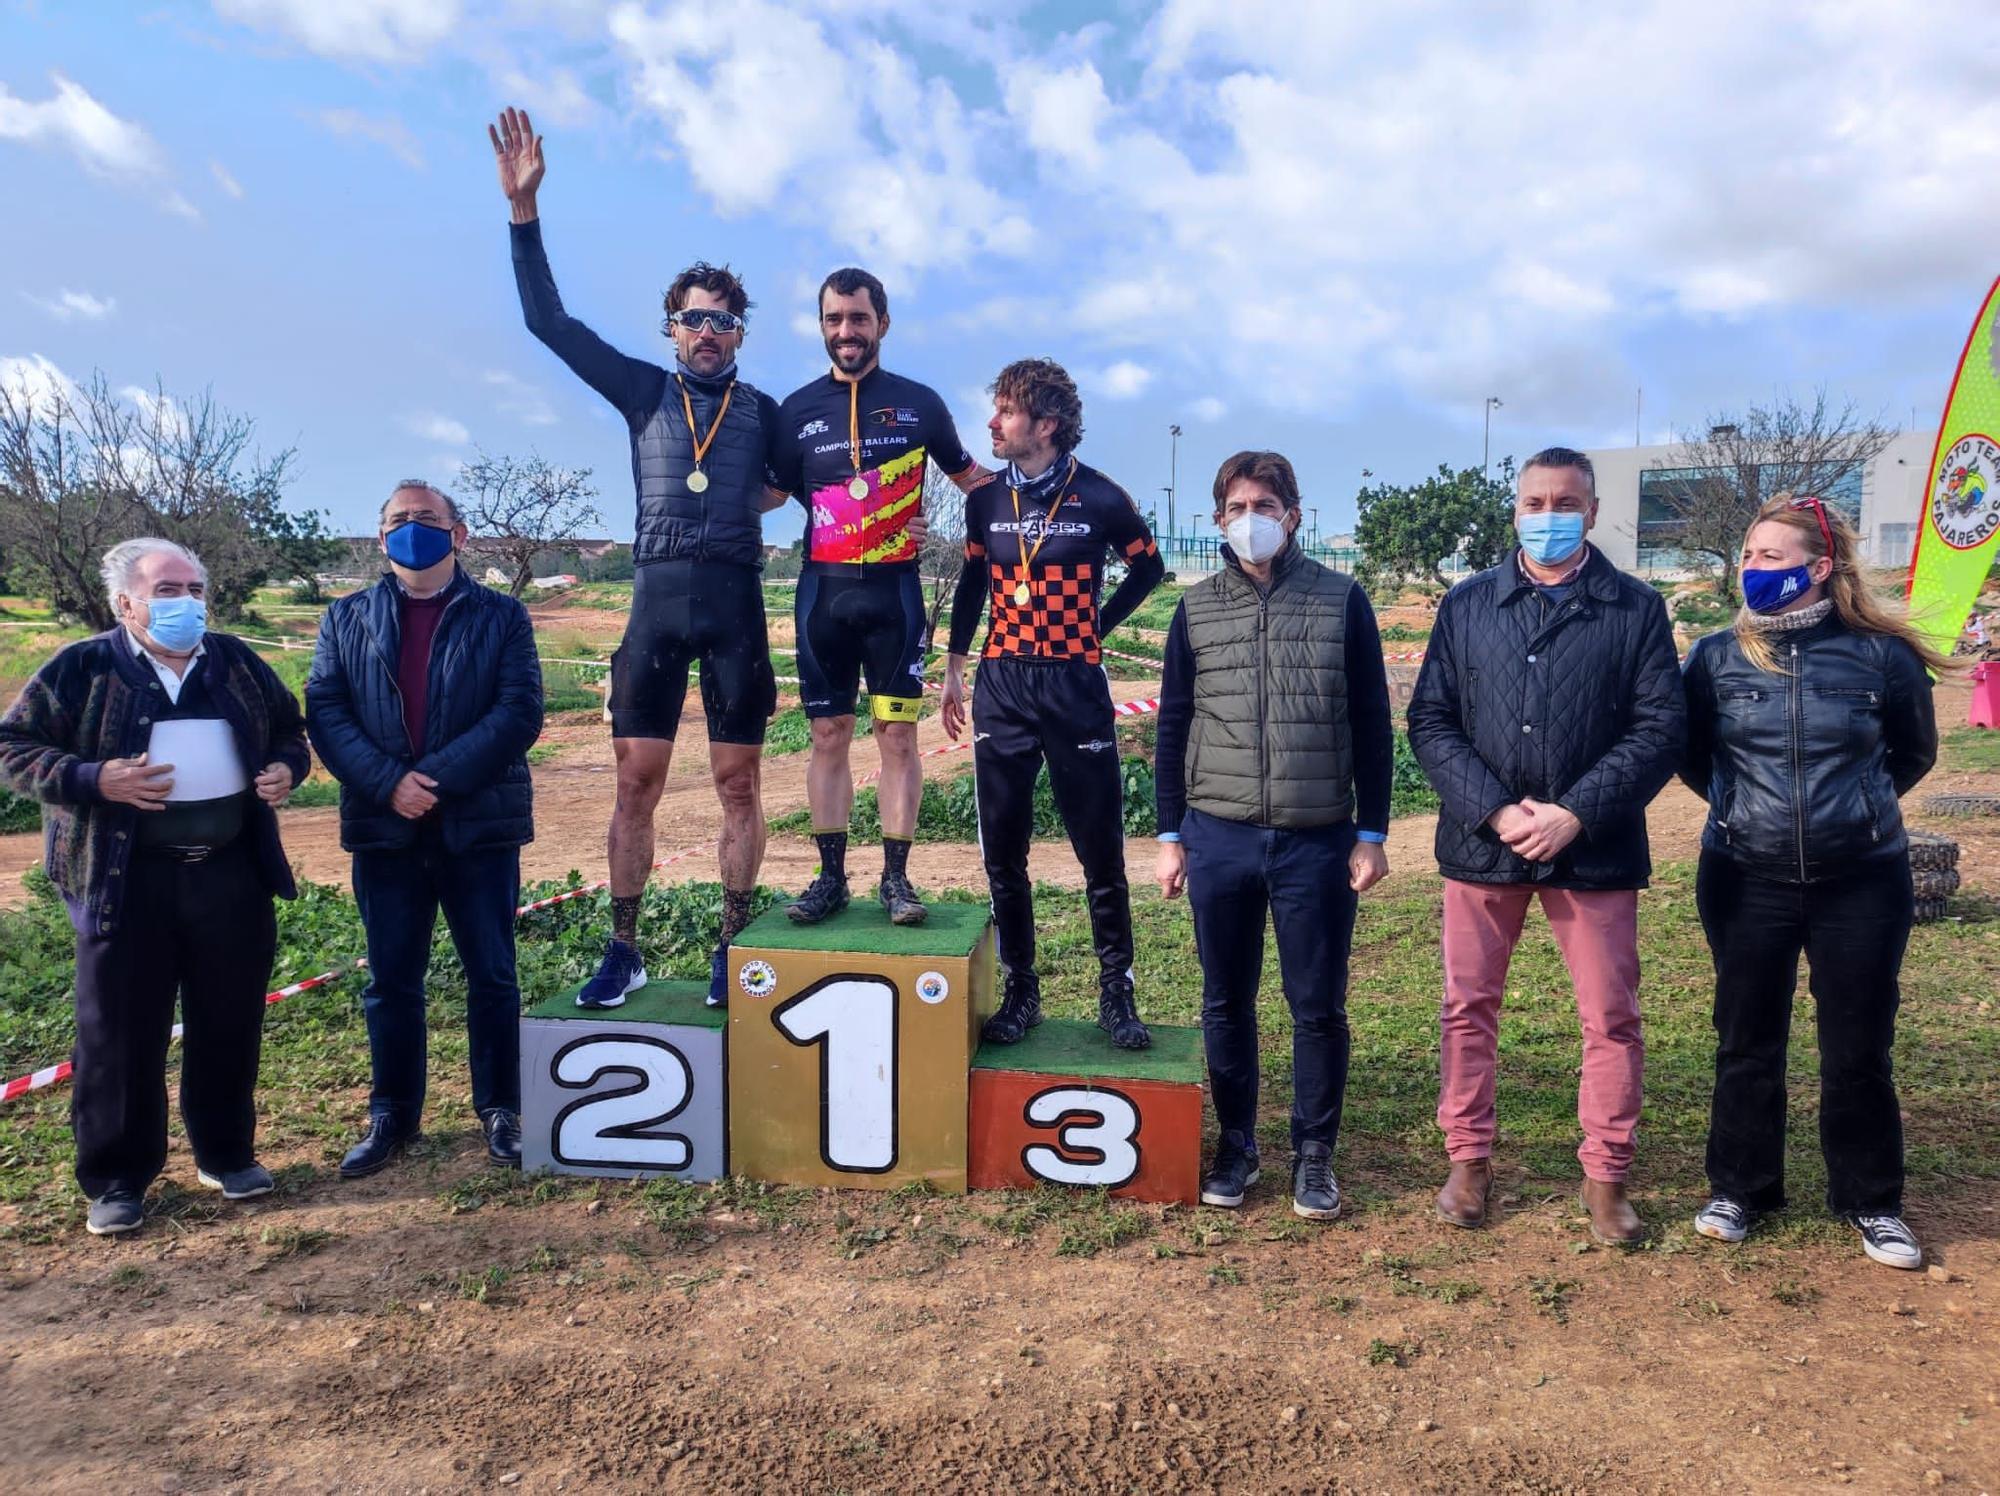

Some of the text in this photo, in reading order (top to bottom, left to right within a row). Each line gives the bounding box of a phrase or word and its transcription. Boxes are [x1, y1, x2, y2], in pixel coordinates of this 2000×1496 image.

[814, 440, 850, 454] CAMPIÓ
[865, 436, 908, 446] BALEARS
[1939, 441, 1970, 483] MOTO
[1934, 500, 2000, 545] PAJAREROS
[551, 1033, 693, 1171] 2
[770, 973, 899, 1174] 1
[1020, 1084, 1141, 1189] 3
